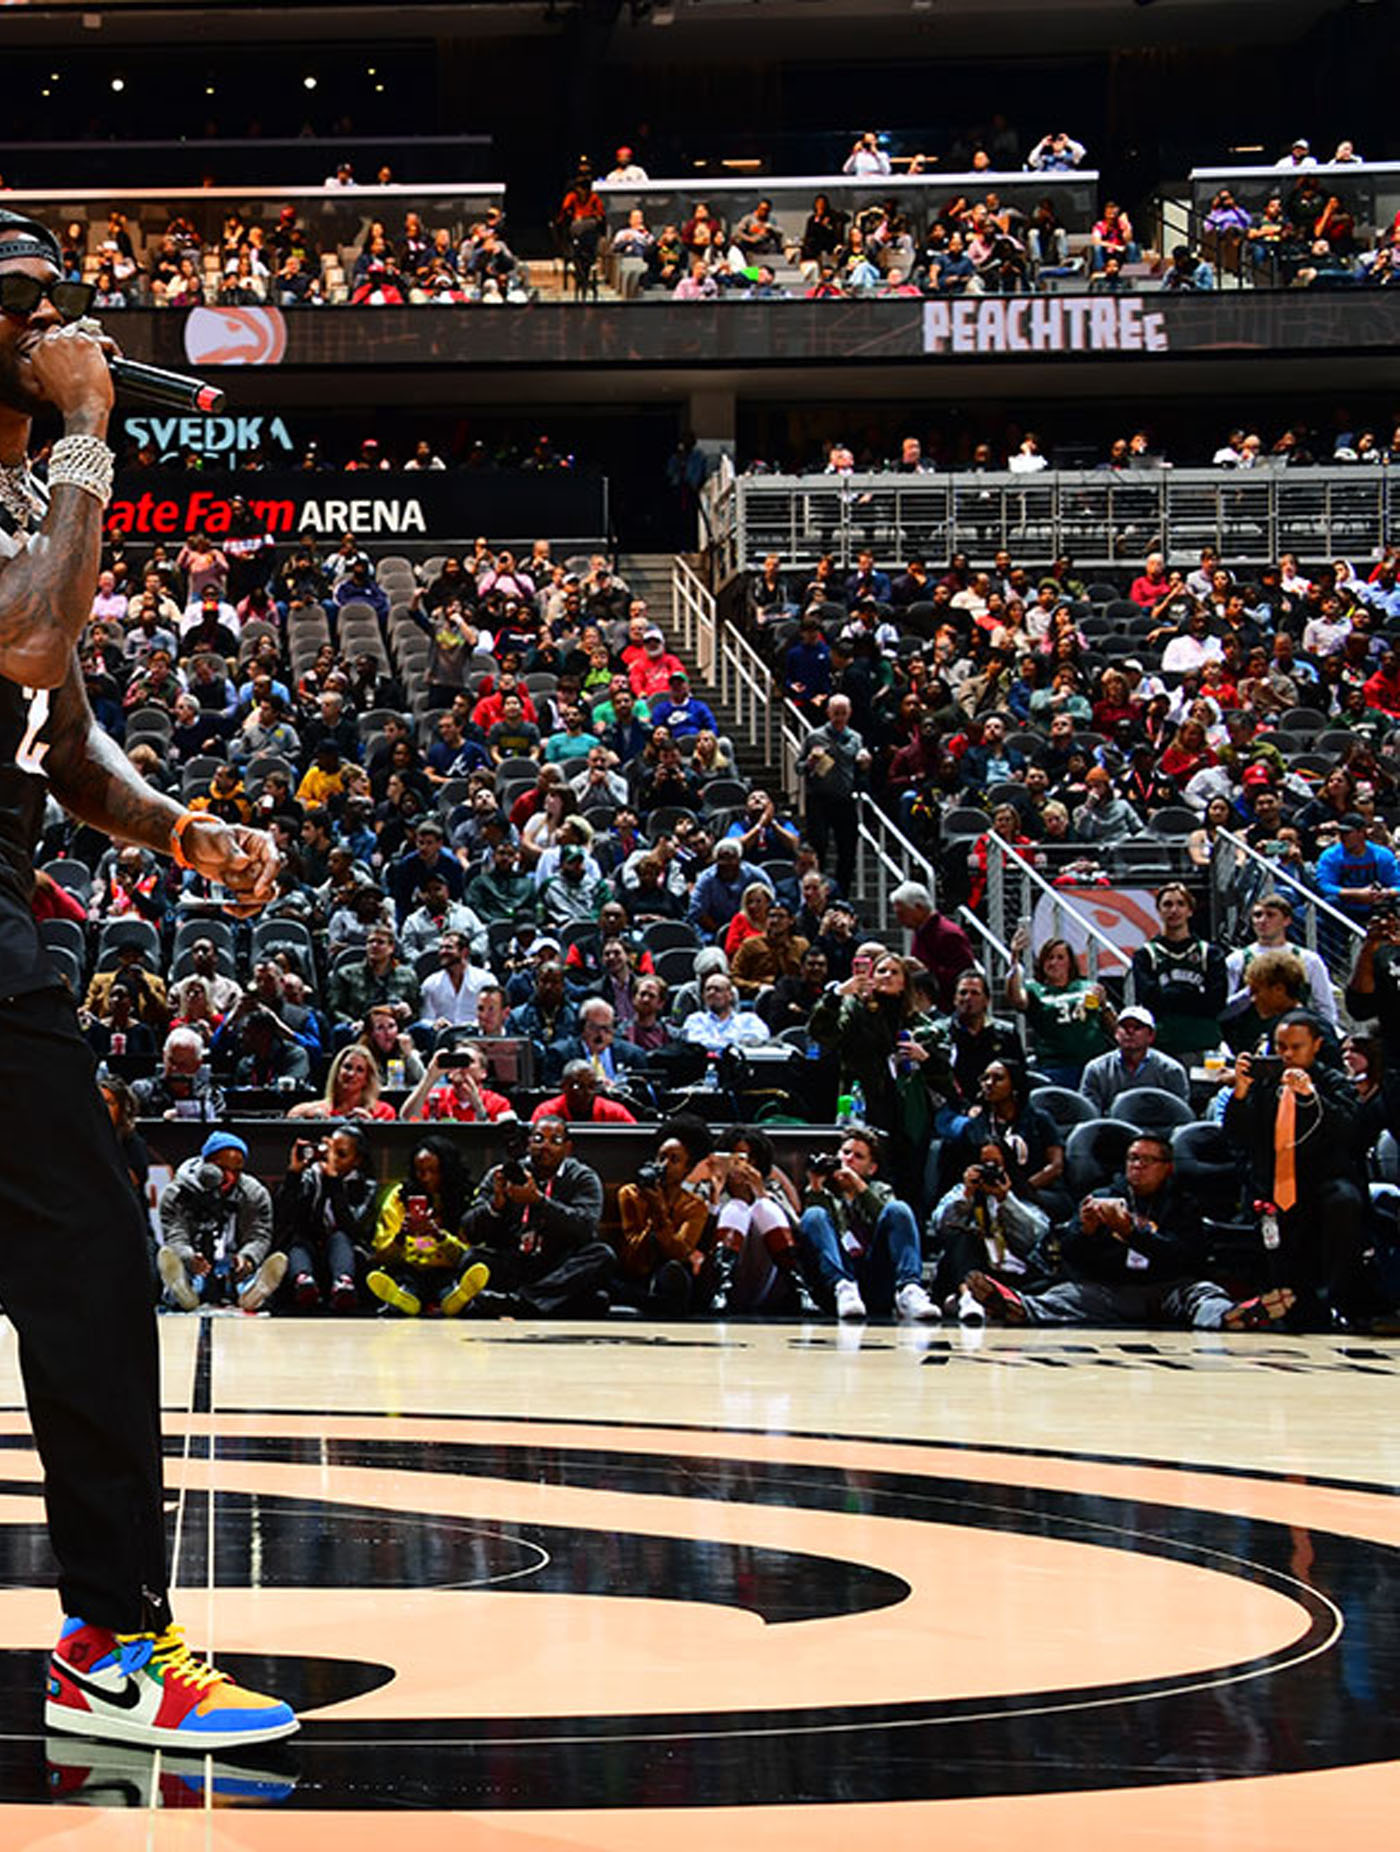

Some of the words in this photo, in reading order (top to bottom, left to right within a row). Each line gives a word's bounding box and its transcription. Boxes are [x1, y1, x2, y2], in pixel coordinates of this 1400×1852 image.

[923, 298, 1168, 351] PEACHTREE
[125, 417, 293, 450] SVEDKA
[102, 492, 179, 532] ate
[184, 491, 295, 532] Fam
[298, 501, 426, 532] ARENA
[1056, 1001, 1087, 1023] 34
